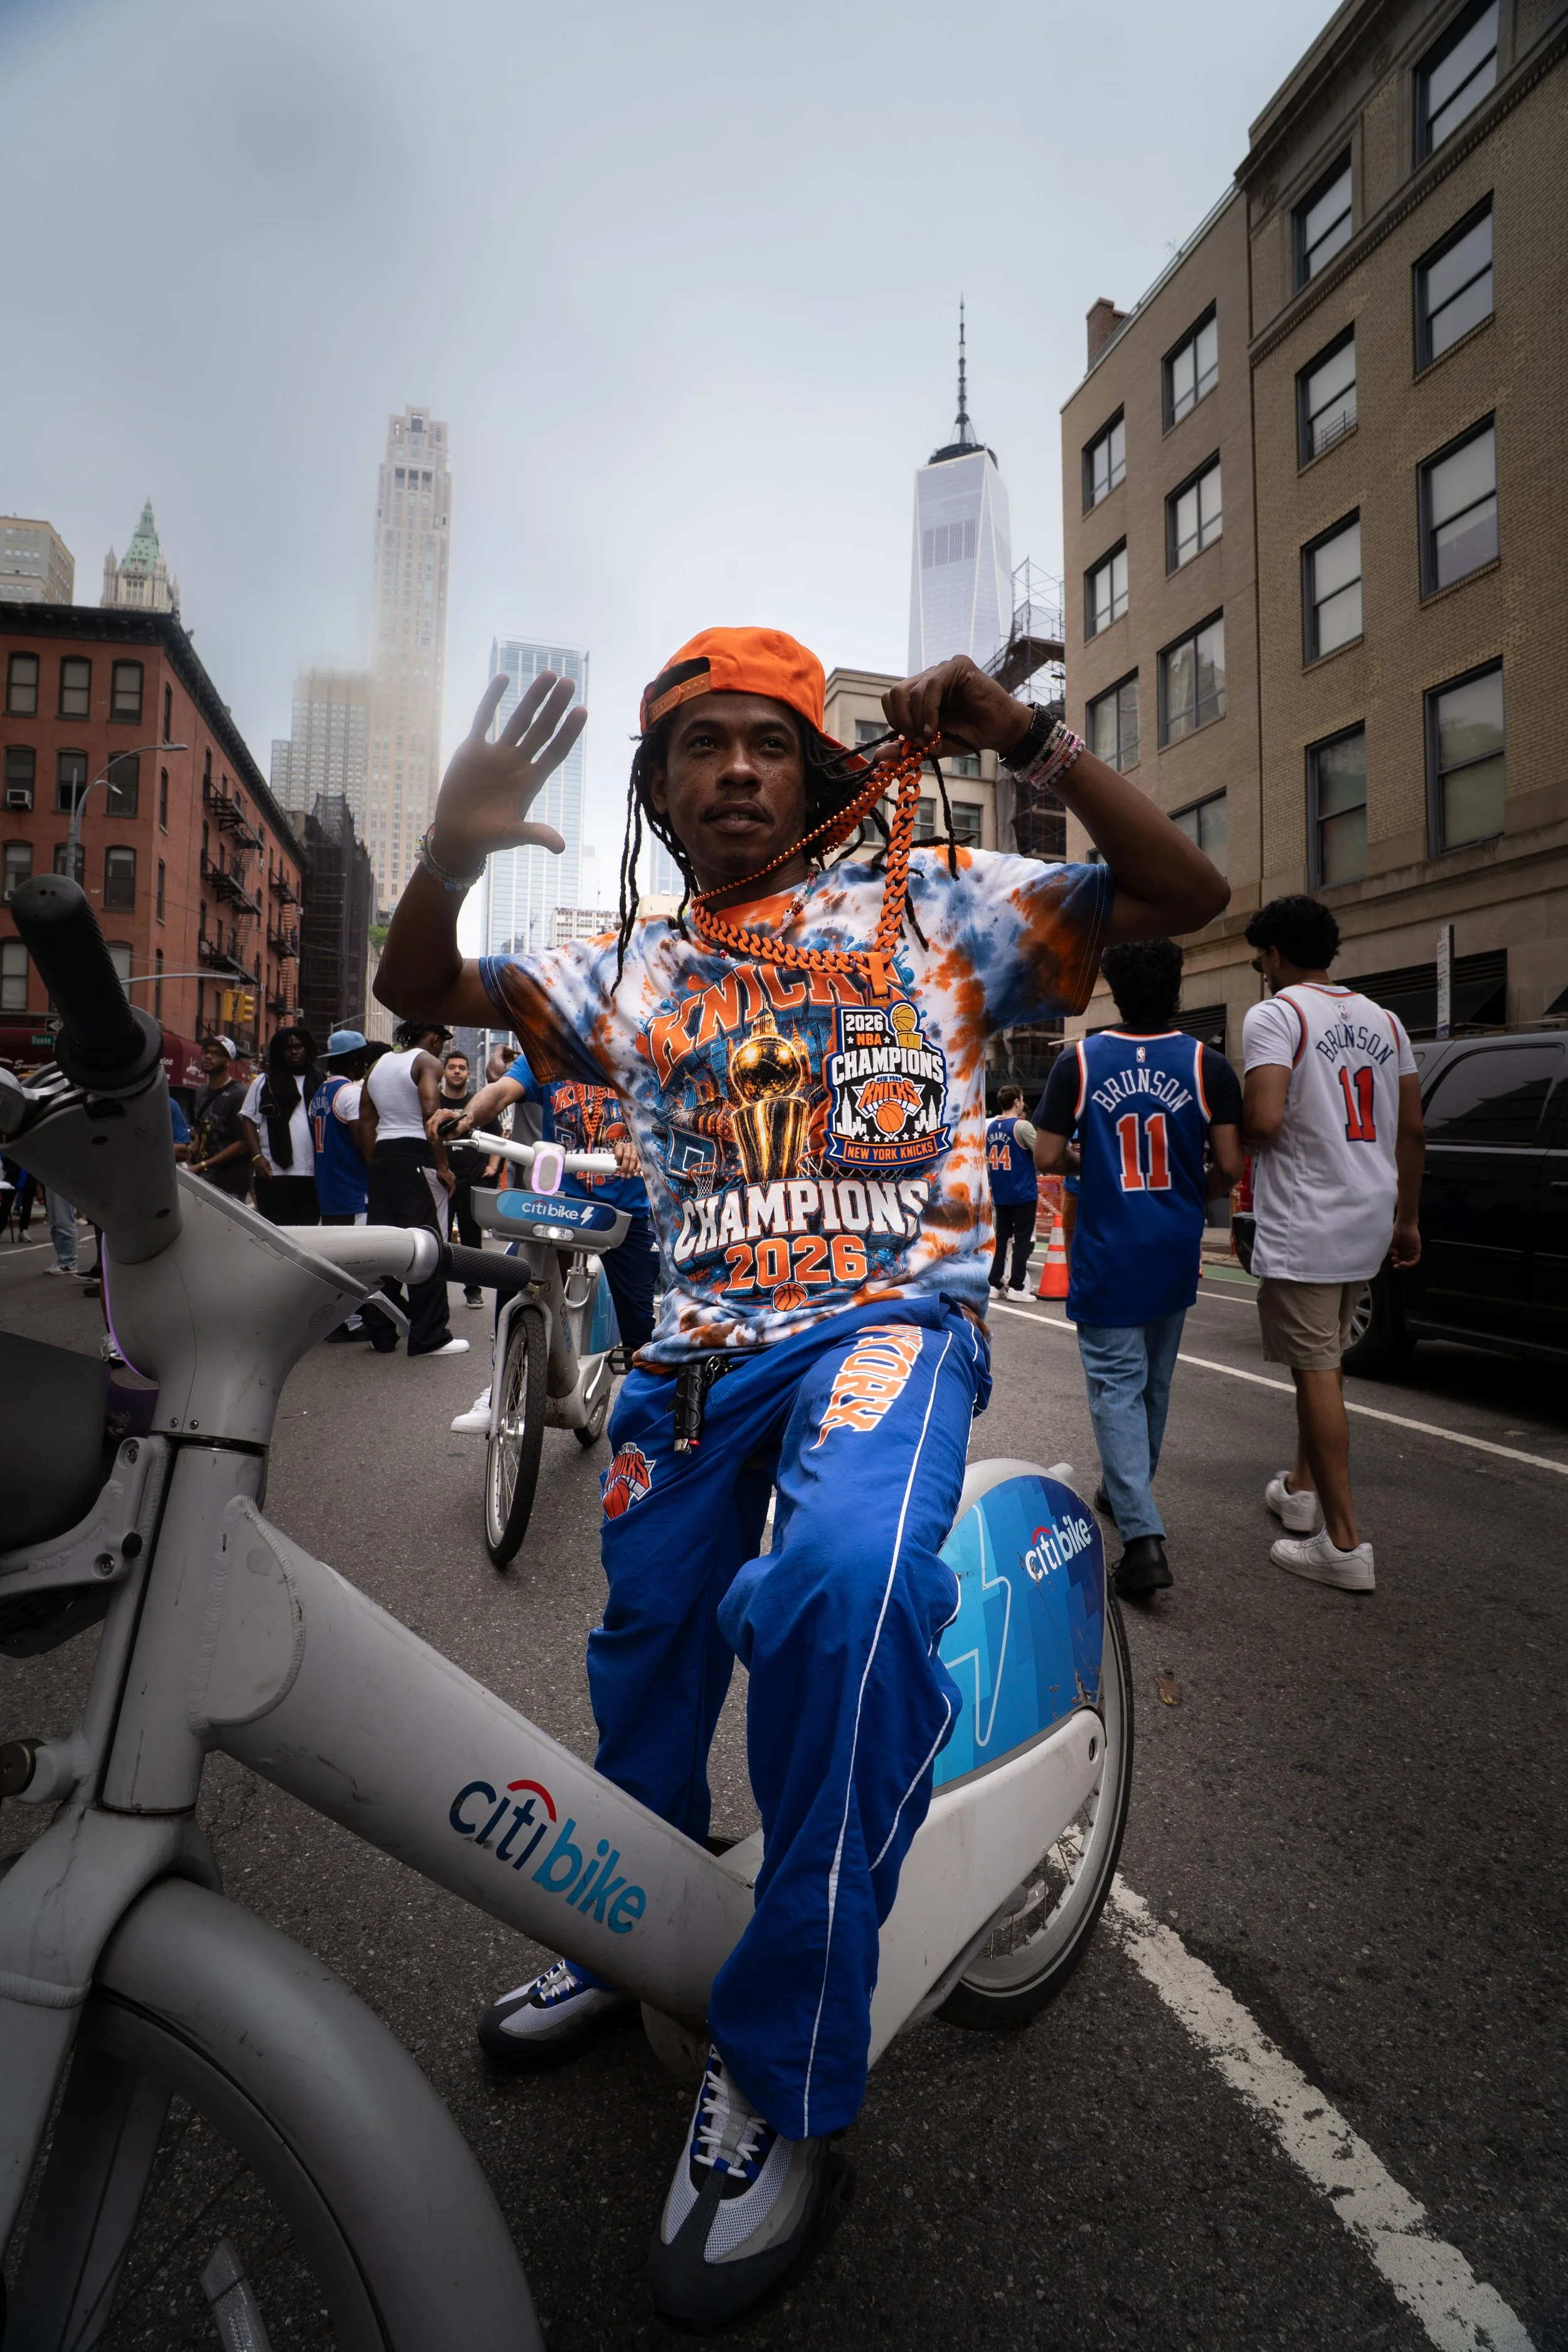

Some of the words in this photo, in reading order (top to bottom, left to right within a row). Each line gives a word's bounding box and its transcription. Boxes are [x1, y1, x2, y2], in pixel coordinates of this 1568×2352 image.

[32, 1036, 51, 1044] Duane
[845, 1014, 883, 1032] 2026
[856, 1033, 882, 1046] NBA
[1315, 1024, 1395, 1065] BRUNSON
[832, 1047, 944, 1086] CHAMPIONS
[858, 1080, 921, 1110] KNICKS
[1092, 1068, 1193, 1113] BRUNSON
[1338, 1065, 1376, 1142] 11
[847, 1146, 870, 1160] NEW
[872, 1148, 898, 1161] YORK
[900, 1142, 934, 1159] KNICKS
[987, 1131, 1011, 1145] SHAMET
[988, 1145, 1012, 1170] 44
[1116, 1113, 1172, 1192] 11
[672, 1178, 931, 1264] CHAMPIONS
[724, 1234, 869, 1291] 2026
[810, 1334, 923, 1450] YORK
[531, 1818, 647, 1934] bike
